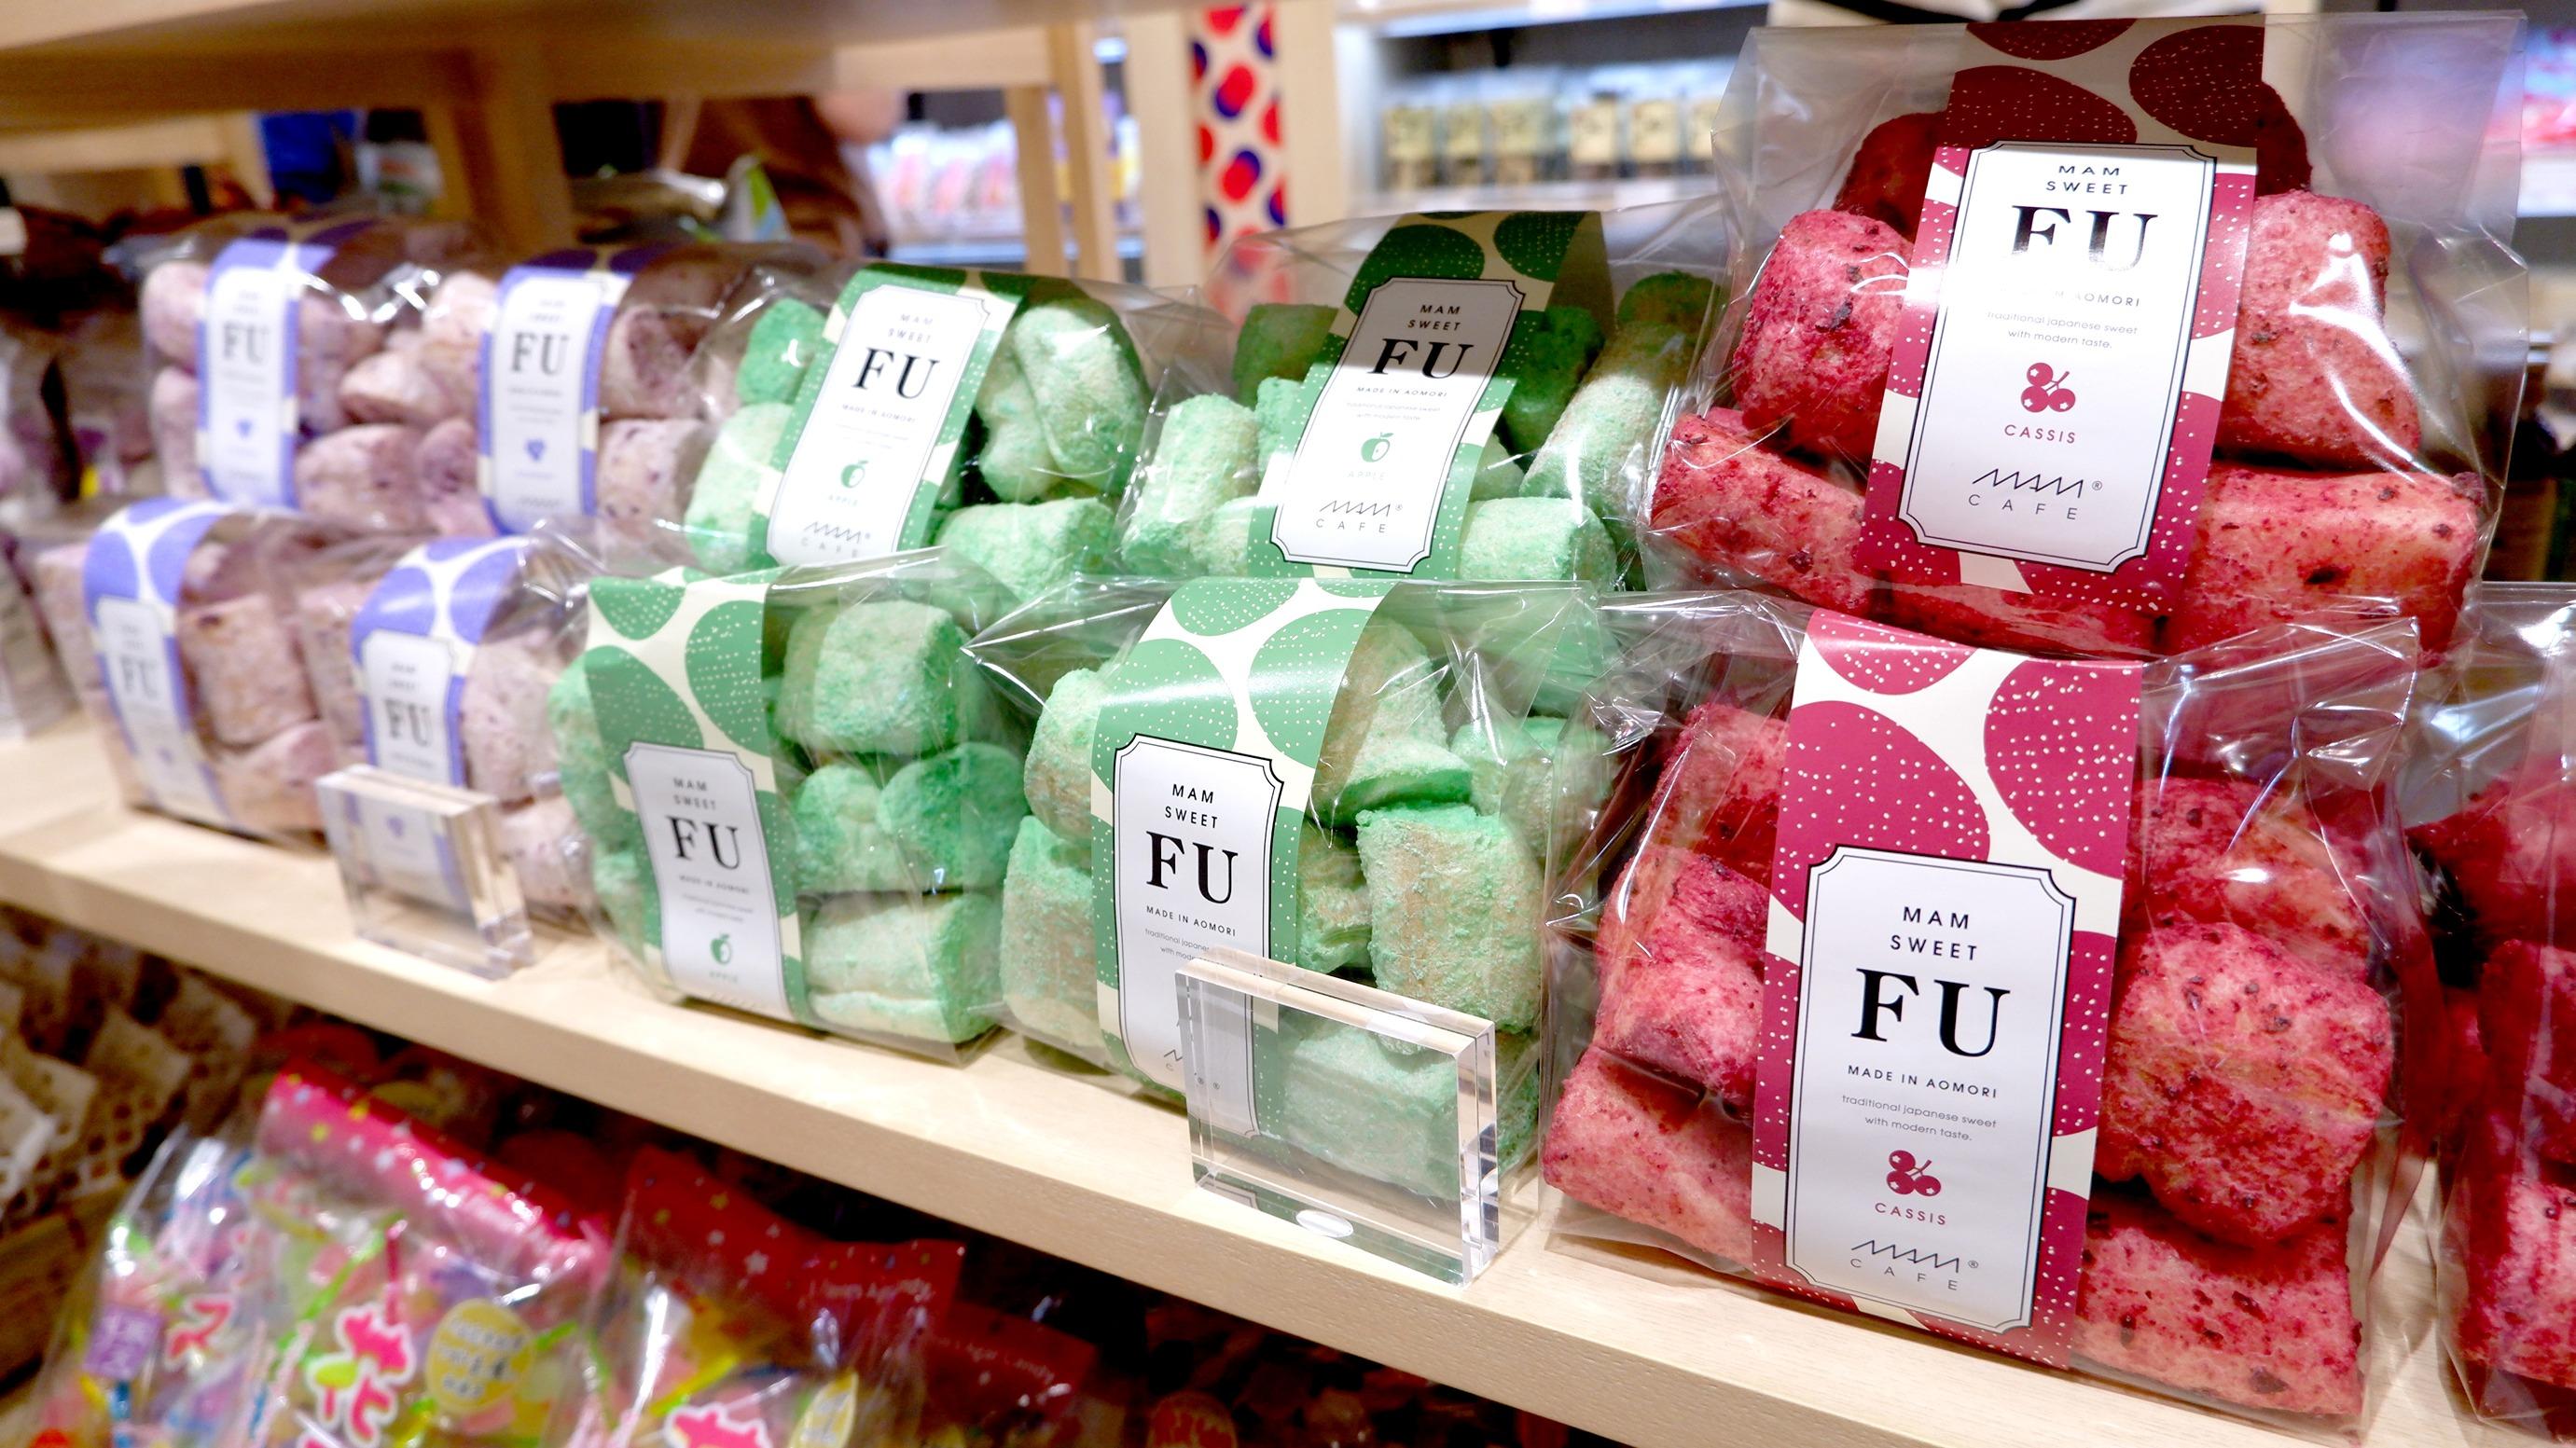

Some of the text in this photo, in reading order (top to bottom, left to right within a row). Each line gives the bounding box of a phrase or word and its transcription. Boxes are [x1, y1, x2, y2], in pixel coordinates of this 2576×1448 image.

[2058, 165, 2121, 176] MAM
[2045, 180, 2128, 195] SWEET
[2007, 204, 2158, 272] FU
[1420, 304, 1461, 315] MAM
[888, 328, 932, 344] SWEET
[1407, 319, 1461, 331] SWEET
[2046, 317, 2100, 331] japanese
[2103, 323, 2139, 335] sweet
[2008, 329, 2112, 349] with modern taste.
[511, 332, 570, 376] FU
[1366, 338, 1474, 379] FU
[851, 347, 940, 399] FU
[1404, 389, 1448, 397] AOMORI
[2004, 423, 2076, 444] CASSIS
[1968, 493, 2078, 520] CAFE
[1315, 518, 1386, 533] CAFE
[383, 697, 434, 747] FU
[672, 777, 708, 792] MAM
[1171, 784, 1213, 804] MAM
[672, 794, 716, 810] SWEET
[1165, 807, 1218, 828] SWEET
[665, 815, 740, 870] FU
[1145, 831, 1239, 904] FU
[1146, 905, 1237, 937] MADE IN AOMORI
[1903, 906, 1970, 930] MAM
[1145, 928, 1209, 952] traditional japane
[1159, 946, 1174, 957] with
[1890, 935, 1978, 961] SWEET
[1850, 968, 2011, 1057] FU
[1848, 1065, 1997, 1098] MADE IN AOMORI
[1842, 1095, 1997, 1128] traditional japanese sweet
[1864, 1116, 1973, 1141] with modern taste.
[1875, 1202, 1947, 1225] CASSIS
[1850, 1258, 1958, 1290] CAFE
